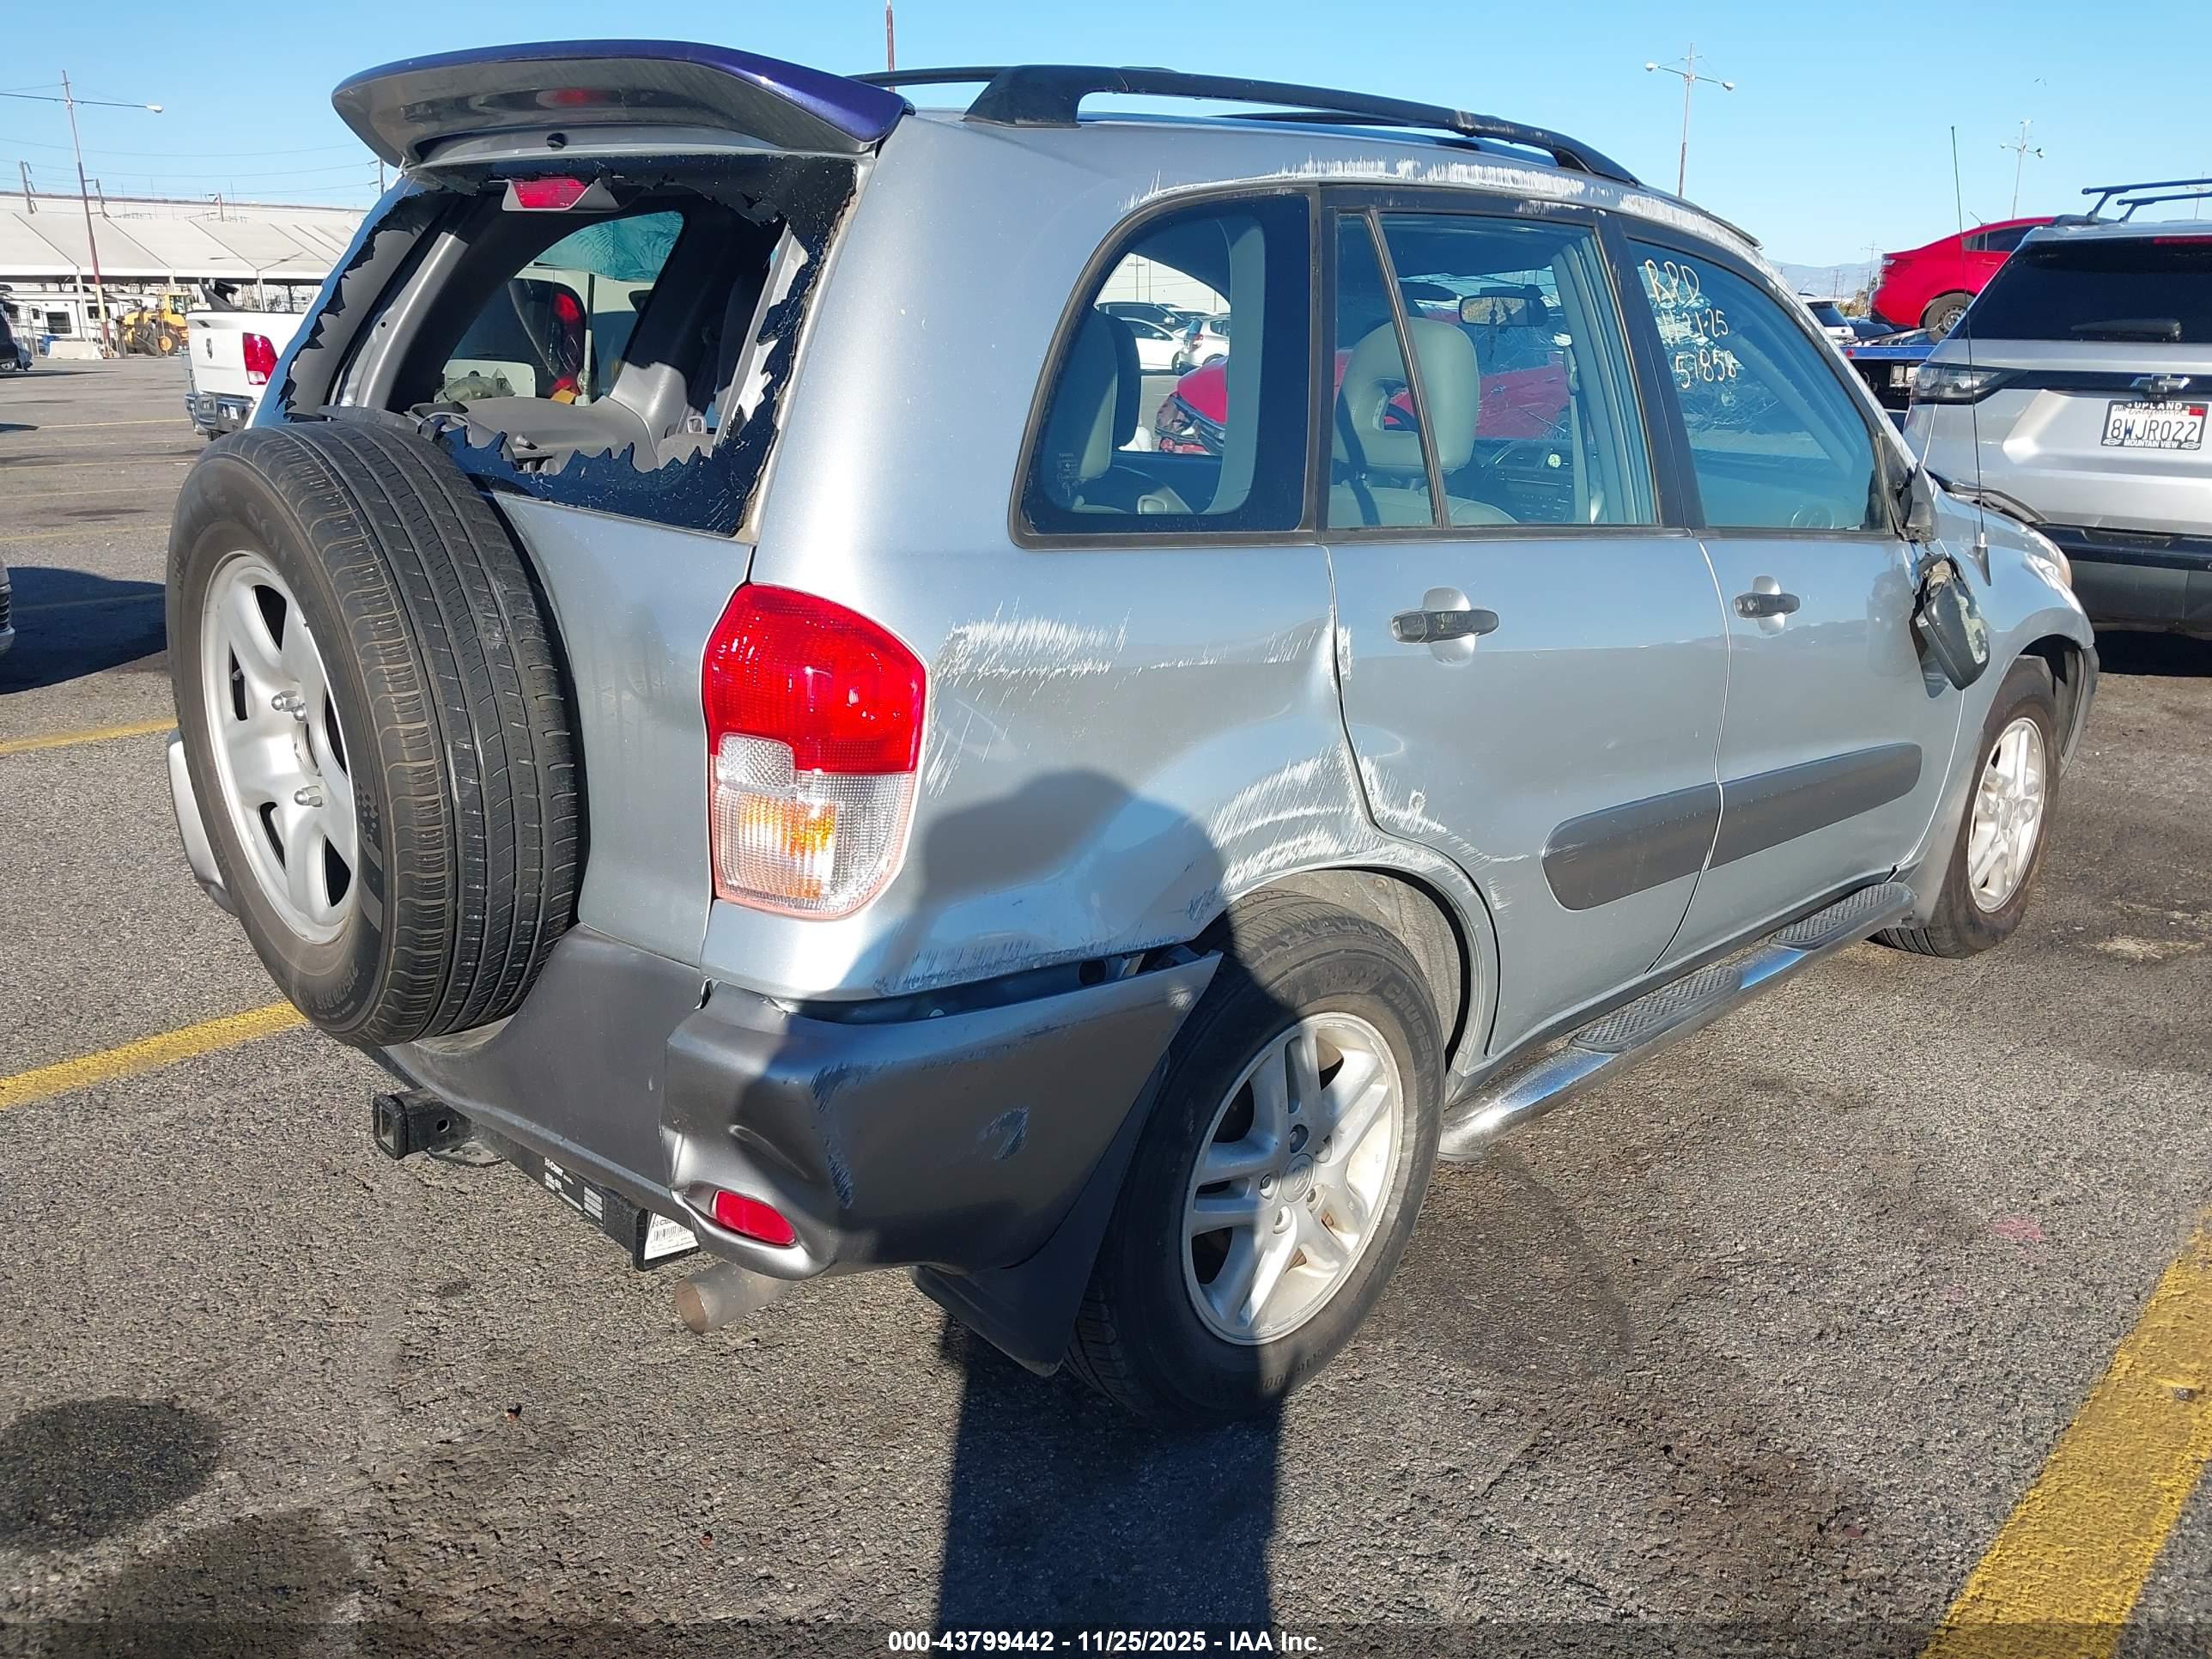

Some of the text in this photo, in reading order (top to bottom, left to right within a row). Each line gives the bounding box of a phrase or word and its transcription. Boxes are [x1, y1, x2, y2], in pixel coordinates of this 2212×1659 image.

[1644, 259, 1699, 303] RPD
[2134, 401, 2183, 410] UPLAND
[2111, 418, 2197, 441] 8WJR022
[2124, 439, 2179, 448] MOUNTAIN VIEW
